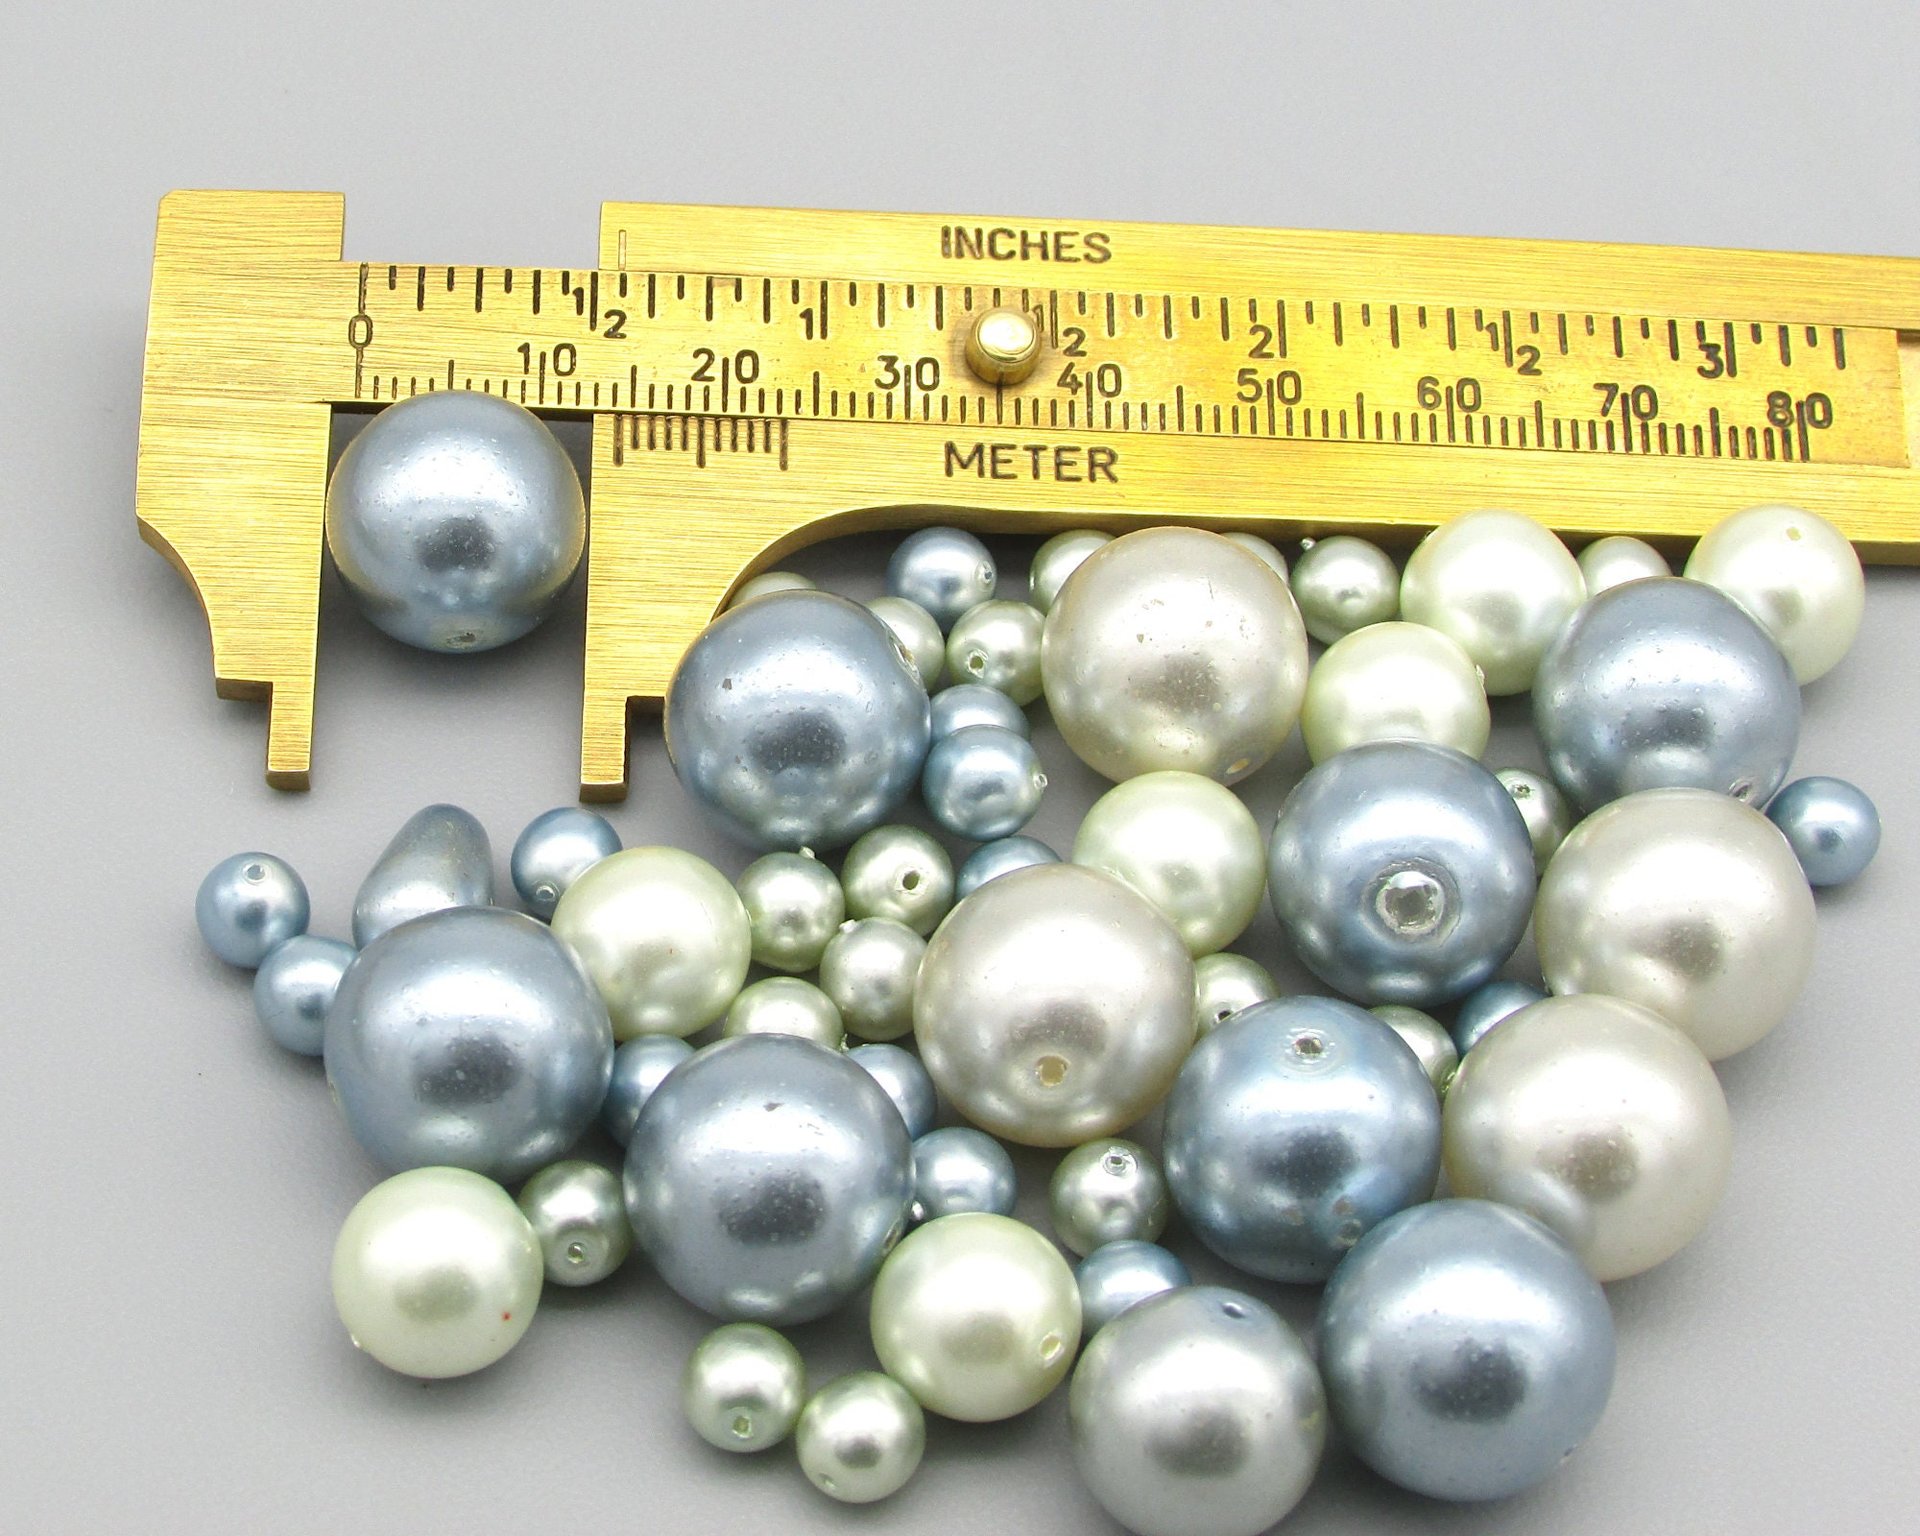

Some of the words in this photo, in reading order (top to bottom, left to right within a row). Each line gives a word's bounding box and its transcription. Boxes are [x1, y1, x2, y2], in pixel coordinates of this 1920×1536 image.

[941, 225, 1112, 263] INCHES
[347, 314, 373, 349] 0
[800, 308, 814, 340] 1
[1248, 324, 1275, 359] 2
[1697, 342, 1724, 379] 3
[944, 440, 1118, 483] METER
